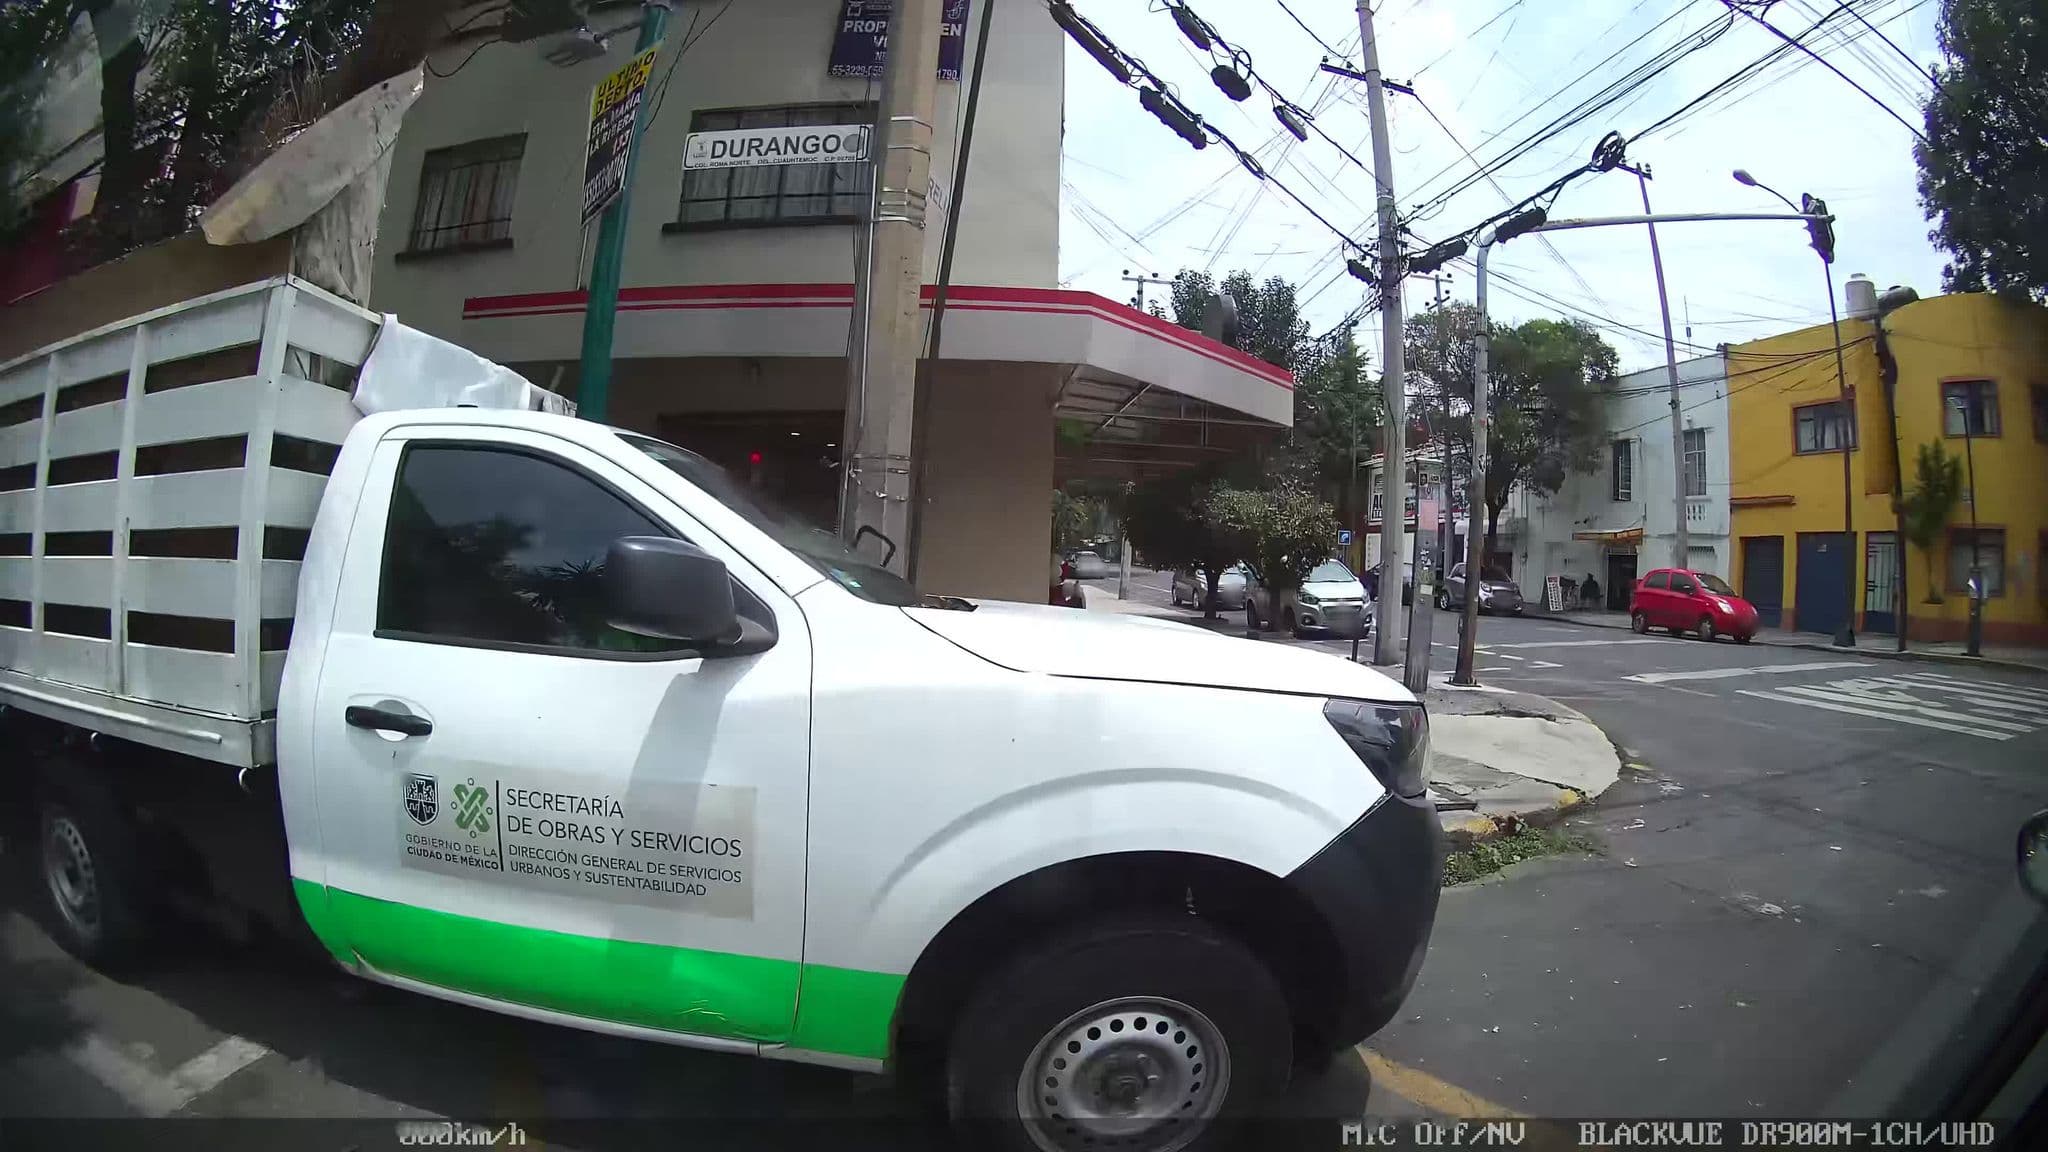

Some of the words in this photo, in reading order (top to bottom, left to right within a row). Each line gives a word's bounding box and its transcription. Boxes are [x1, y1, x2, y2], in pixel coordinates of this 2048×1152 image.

[710, 134, 842, 159] DURANGO
[506, 788, 624, 819] SECRETARÍA
[405, 833, 462, 851] GOBIERNO
[465, 844, 480, 855] DE
[483, 847, 498, 858] LA
[507, 816, 533, 835] DE
[538, 819, 605, 844] OBRAS
[611, 827, 625, 846] Y
[631, 830, 742, 858] SERVICIOS
[407, 846, 442, 860] CIUDAD
[445, 853, 458, 863] DE
[460, 854, 499, 870] MÉXICO
[509, 844, 578, 865] DIRECCIÓN
[581, 854, 643, 873] GENERAL
[647, 862, 666, 875] DE
[669, 864, 742, 883] SERVICIOS
[510, 860, 570, 879] URBANOS
[573, 870, 582, 881] Y
[584, 871, 707, 896] SUSTENTABILIDAD
